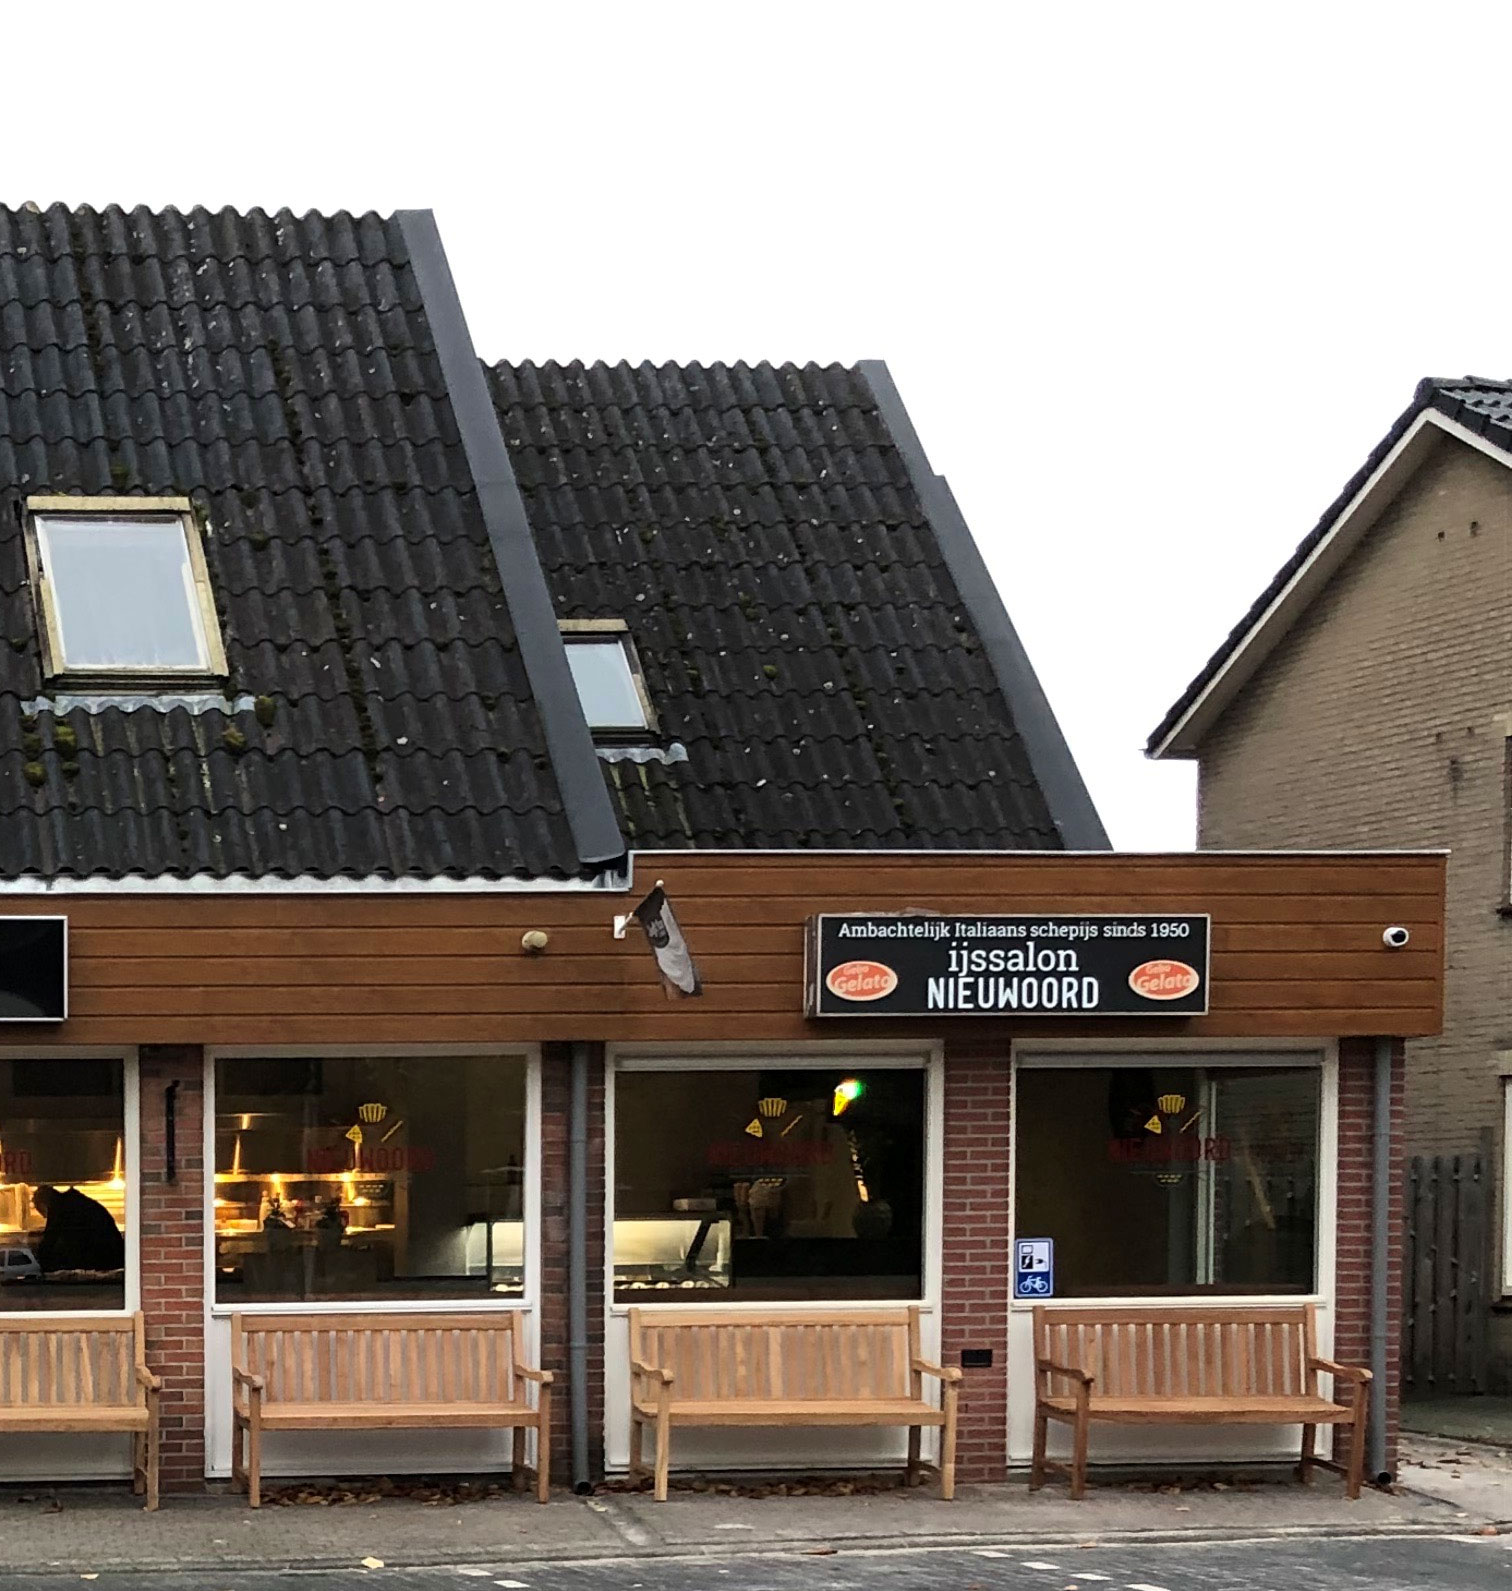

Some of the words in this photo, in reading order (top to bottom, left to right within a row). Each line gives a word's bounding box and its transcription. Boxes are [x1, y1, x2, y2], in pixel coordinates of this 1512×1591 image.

[838, 922, 950, 941] Ambachtelijk
[954, 922, 1027, 938] Italiaans
[1030, 922, 1099, 941] schepijs
[1103, 922, 1147, 938] sinds
[1150, 922, 1190, 938] 1950
[947, 941, 1080, 977] ijssalon
[833, 974, 892, 993] Gelato
[927, 976, 1100, 1010] NIEUWOORD
